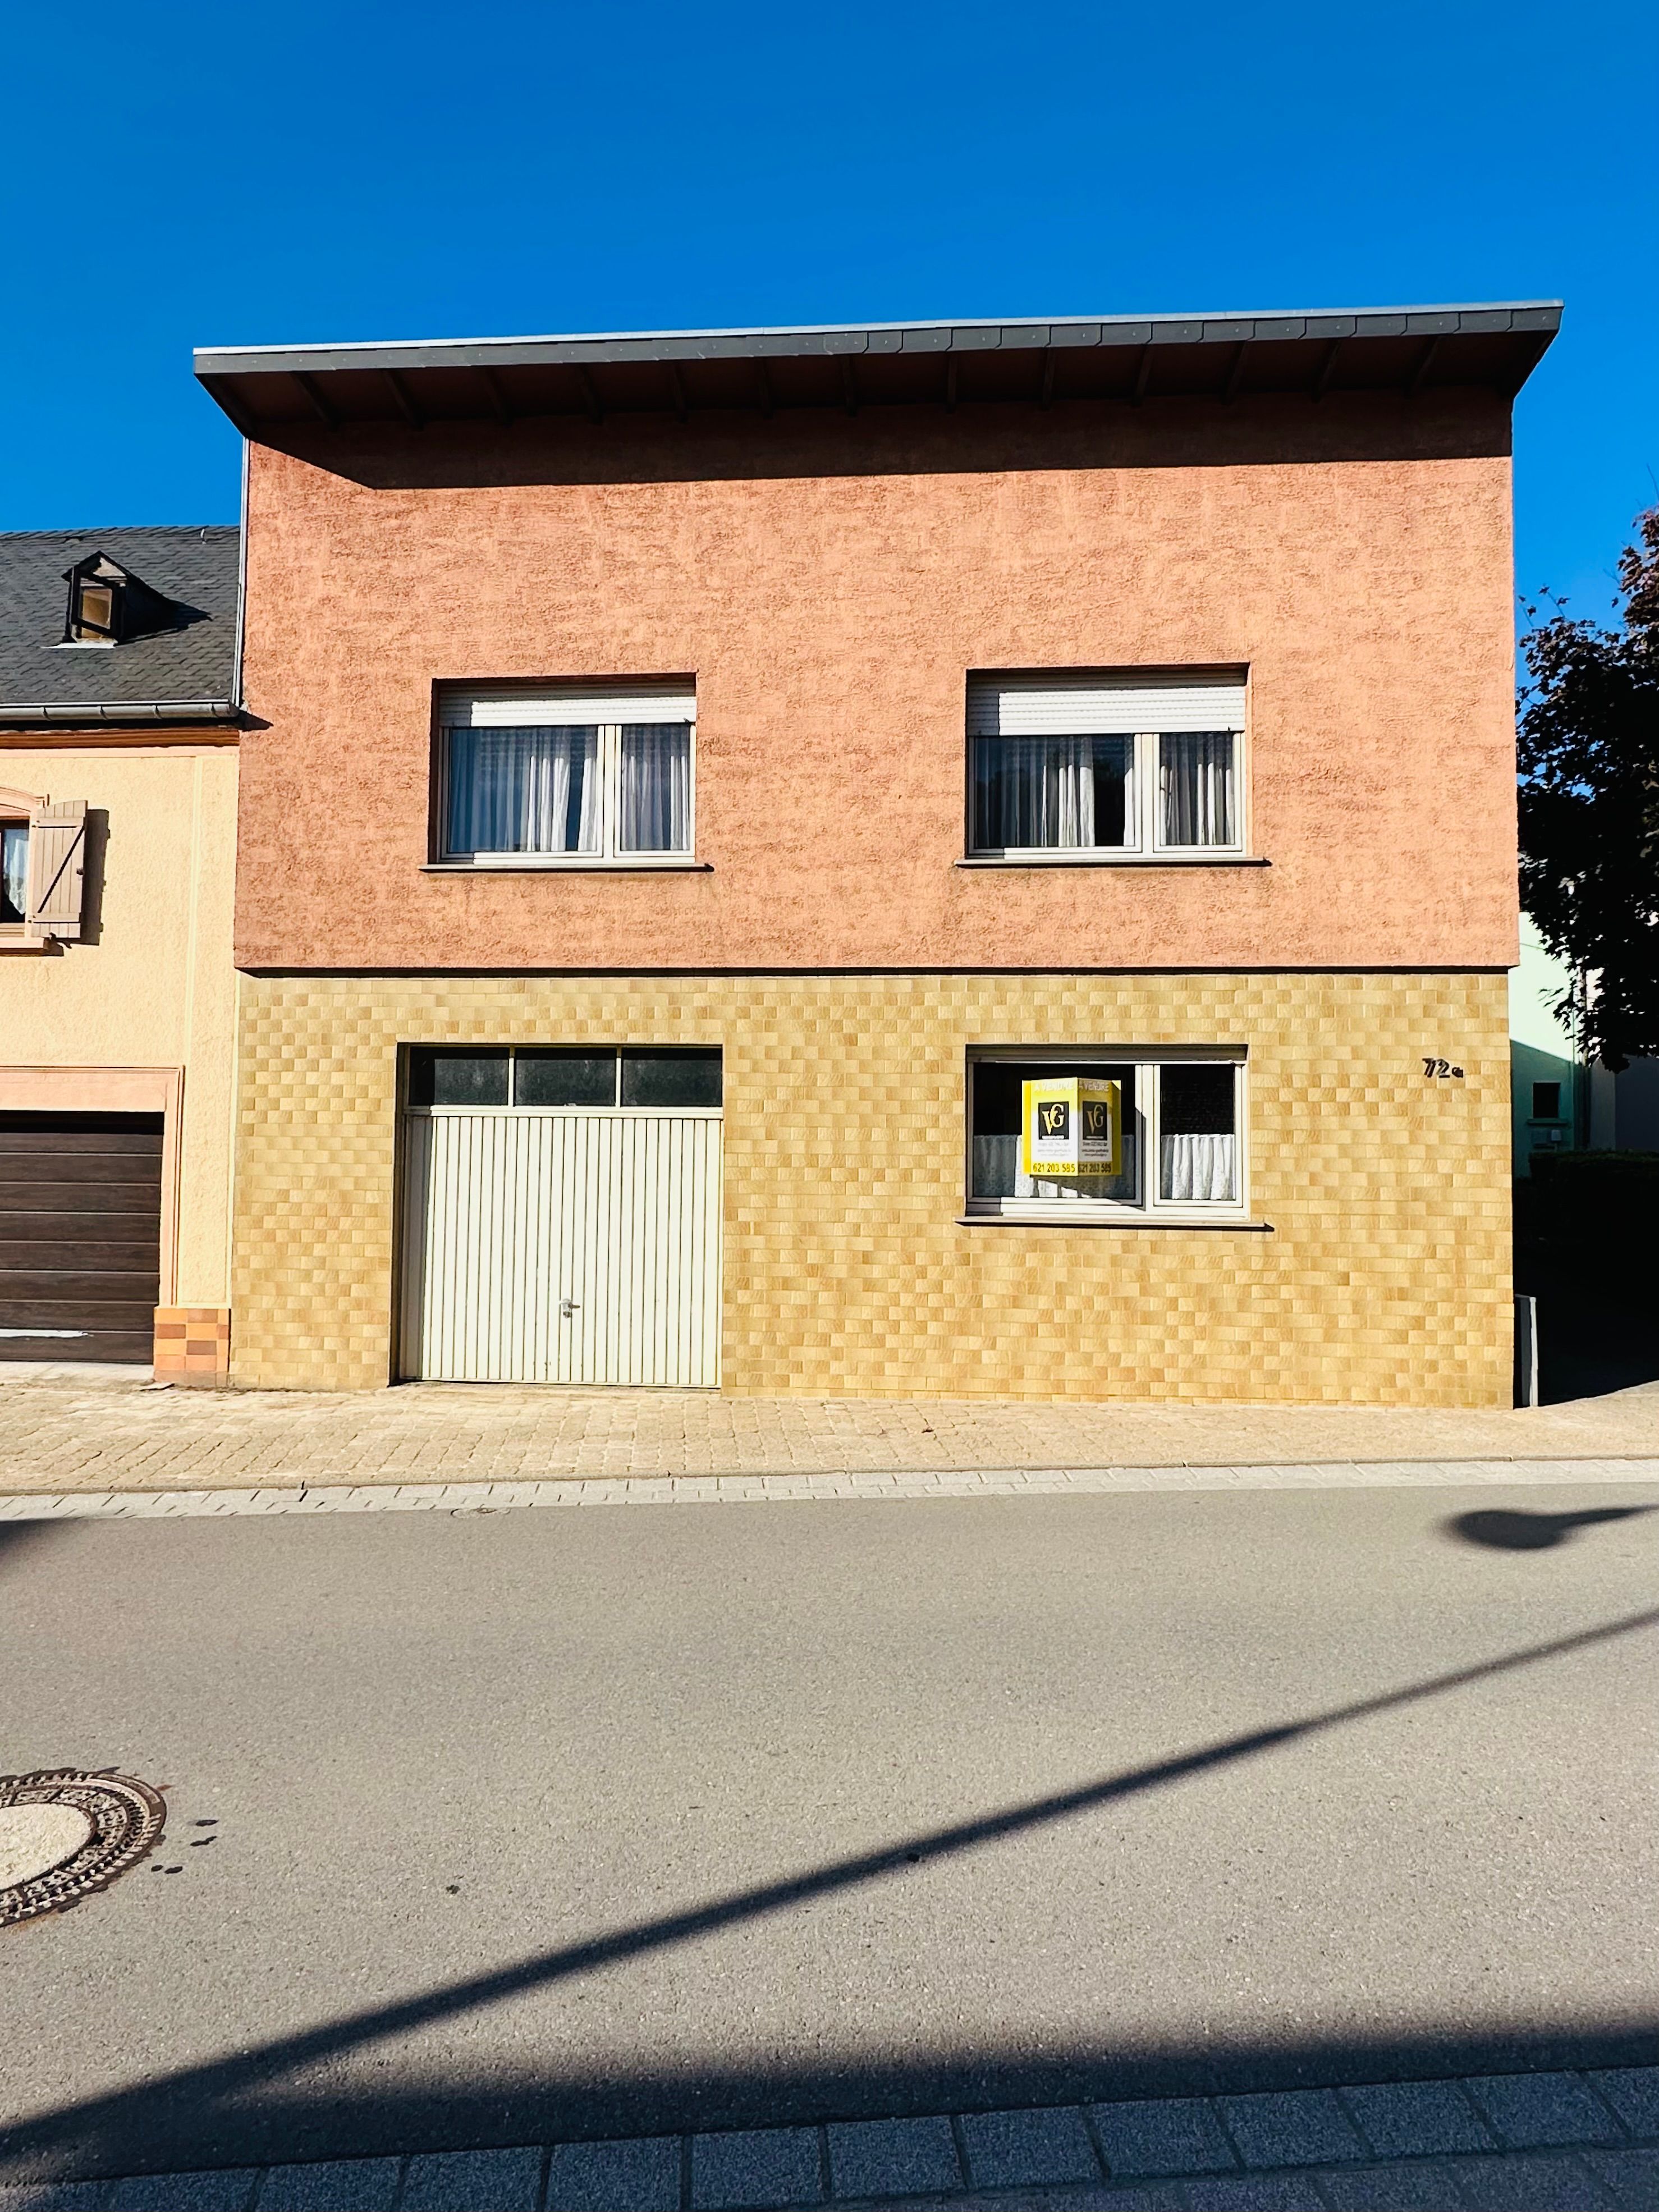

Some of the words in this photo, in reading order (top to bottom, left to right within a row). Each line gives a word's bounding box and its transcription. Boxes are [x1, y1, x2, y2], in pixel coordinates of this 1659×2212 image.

[1422, 1058, 1464, 1078] 72a
[1033, 1163, 1044, 1173] 621
[1047, 1163, 1060, 1173] 203
